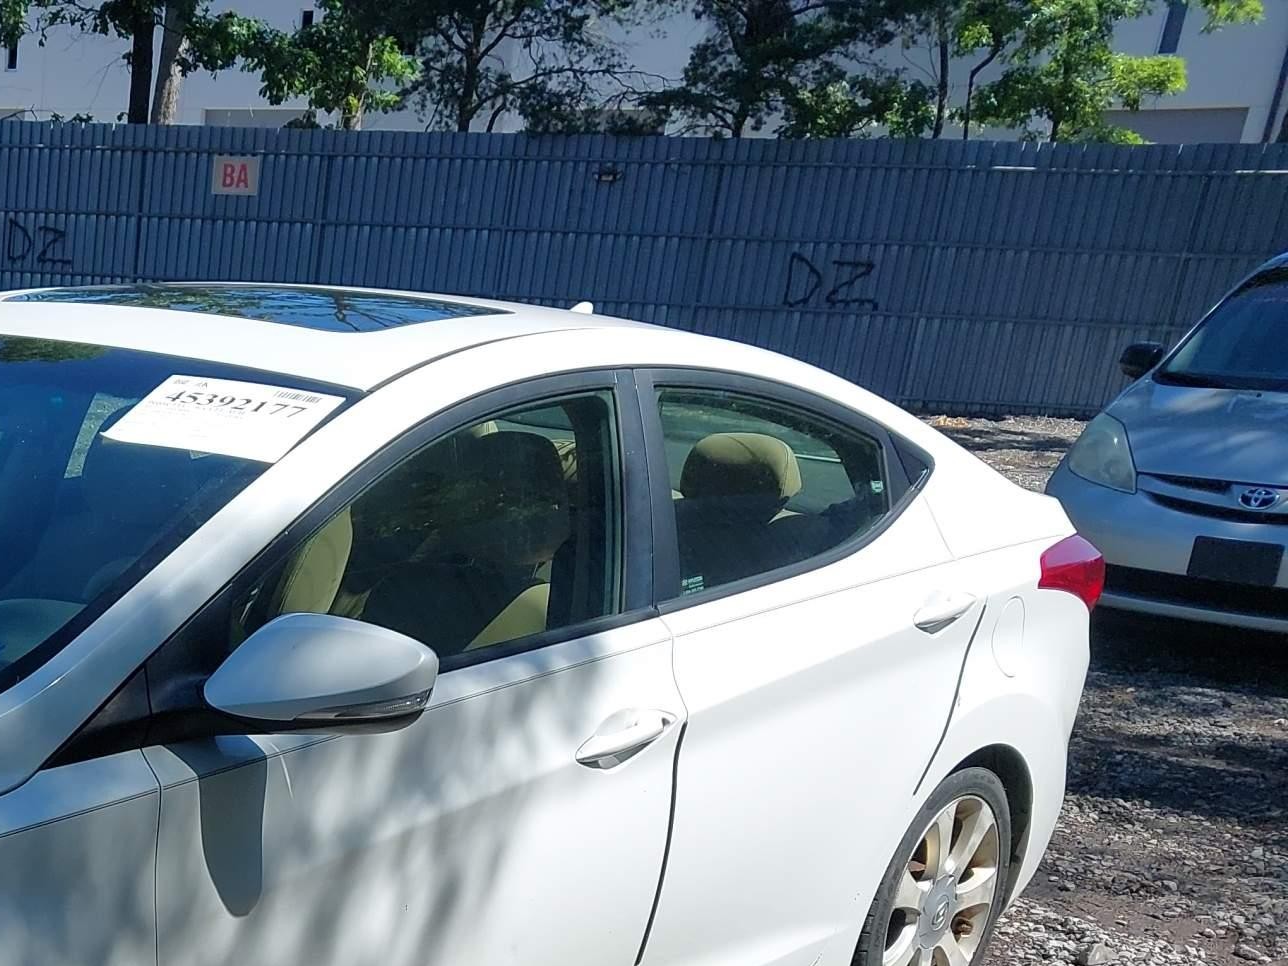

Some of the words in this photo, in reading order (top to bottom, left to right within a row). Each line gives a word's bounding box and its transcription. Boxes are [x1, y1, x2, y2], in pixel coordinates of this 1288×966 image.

[223, 163, 249, 189] BA
[8, 218, 72, 264] DZ
[783, 252, 878, 311] DZ
[166, 390, 308, 418] 45392177
